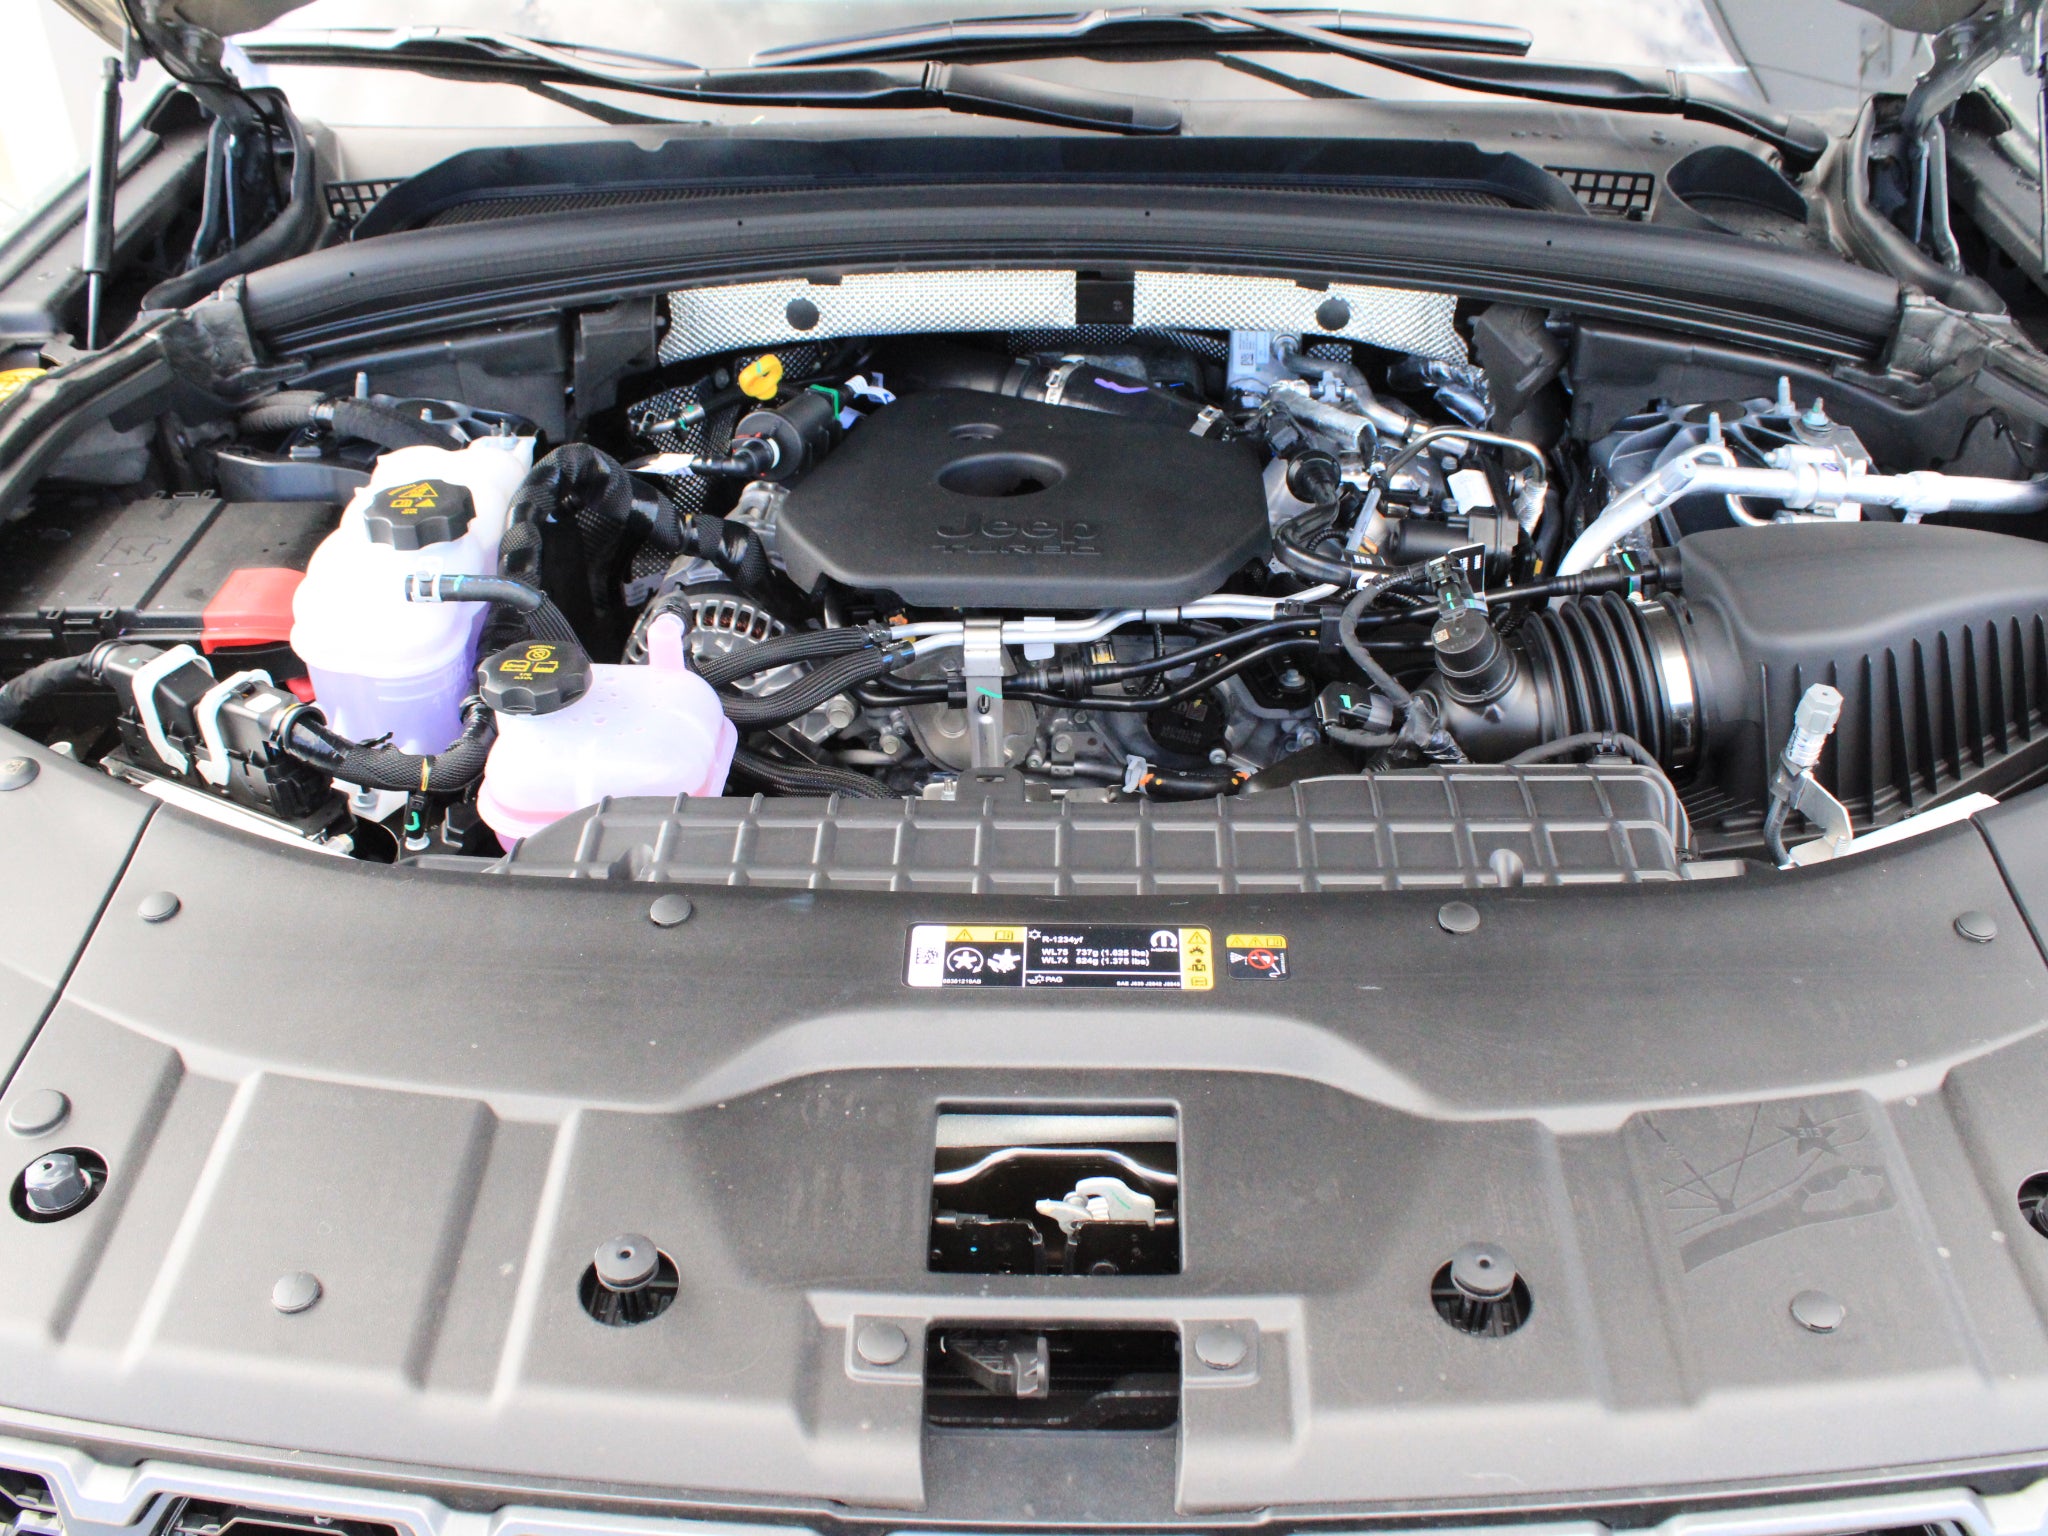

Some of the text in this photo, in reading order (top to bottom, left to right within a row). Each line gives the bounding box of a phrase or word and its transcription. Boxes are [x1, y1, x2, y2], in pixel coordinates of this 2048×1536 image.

[936, 512, 1099, 544] Jeep
[1041, 935, 1084, 945] R-1234yf
[1076, 948, 1099, 958] 737g
[1100, 949, 1130, 958] (1.625
[1131, 949, 1150, 958] lbs)
[1041, 956, 1150, 967] WL74 624g (1.375 lbs)
[1045, 976, 1064, 984] PAG
[1796, 1127, 1822, 1138] 313
